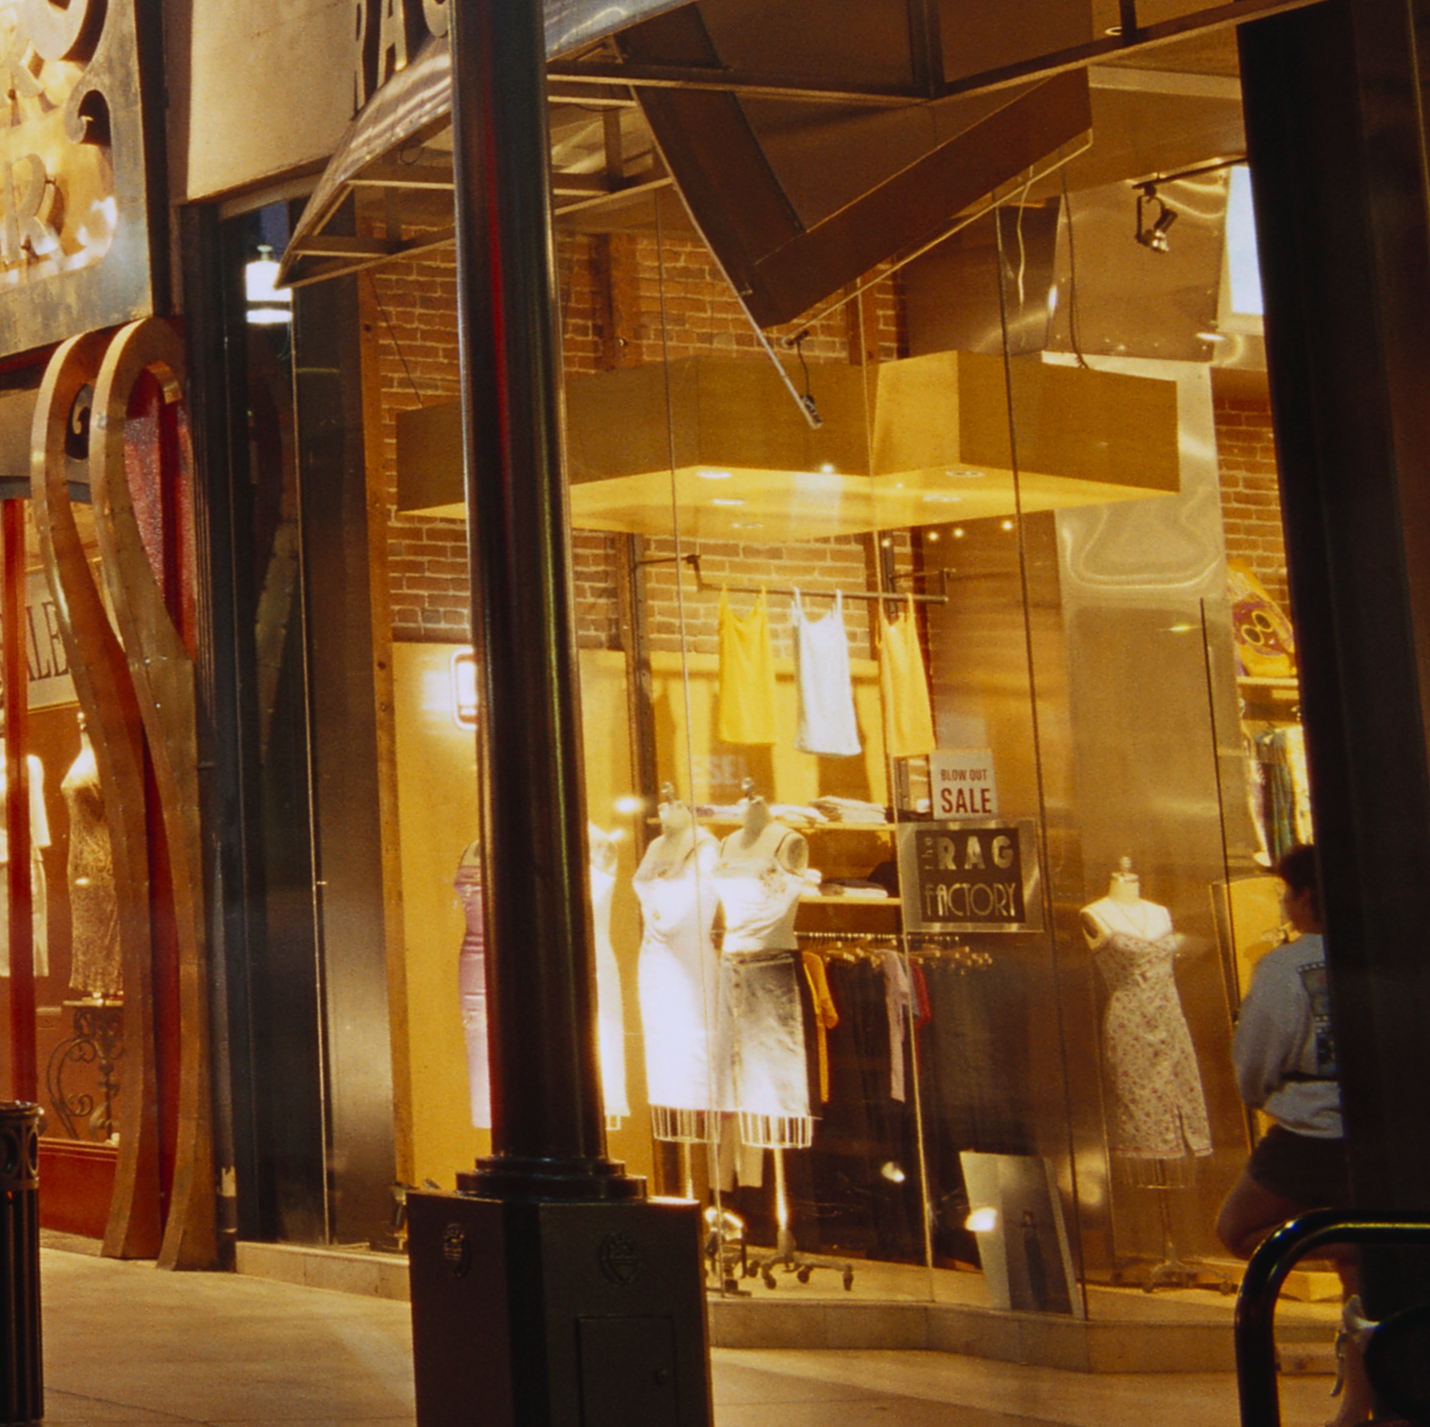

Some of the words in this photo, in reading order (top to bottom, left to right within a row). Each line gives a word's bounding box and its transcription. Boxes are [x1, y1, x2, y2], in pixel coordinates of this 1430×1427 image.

[940, 768, 967, 781] BLOW
[969, 768, 988, 780] OUT
[940, 787, 992, 814] SALE
[937, 834, 1015, 871] RAG
[923, 881, 1017, 917] FACTORY
